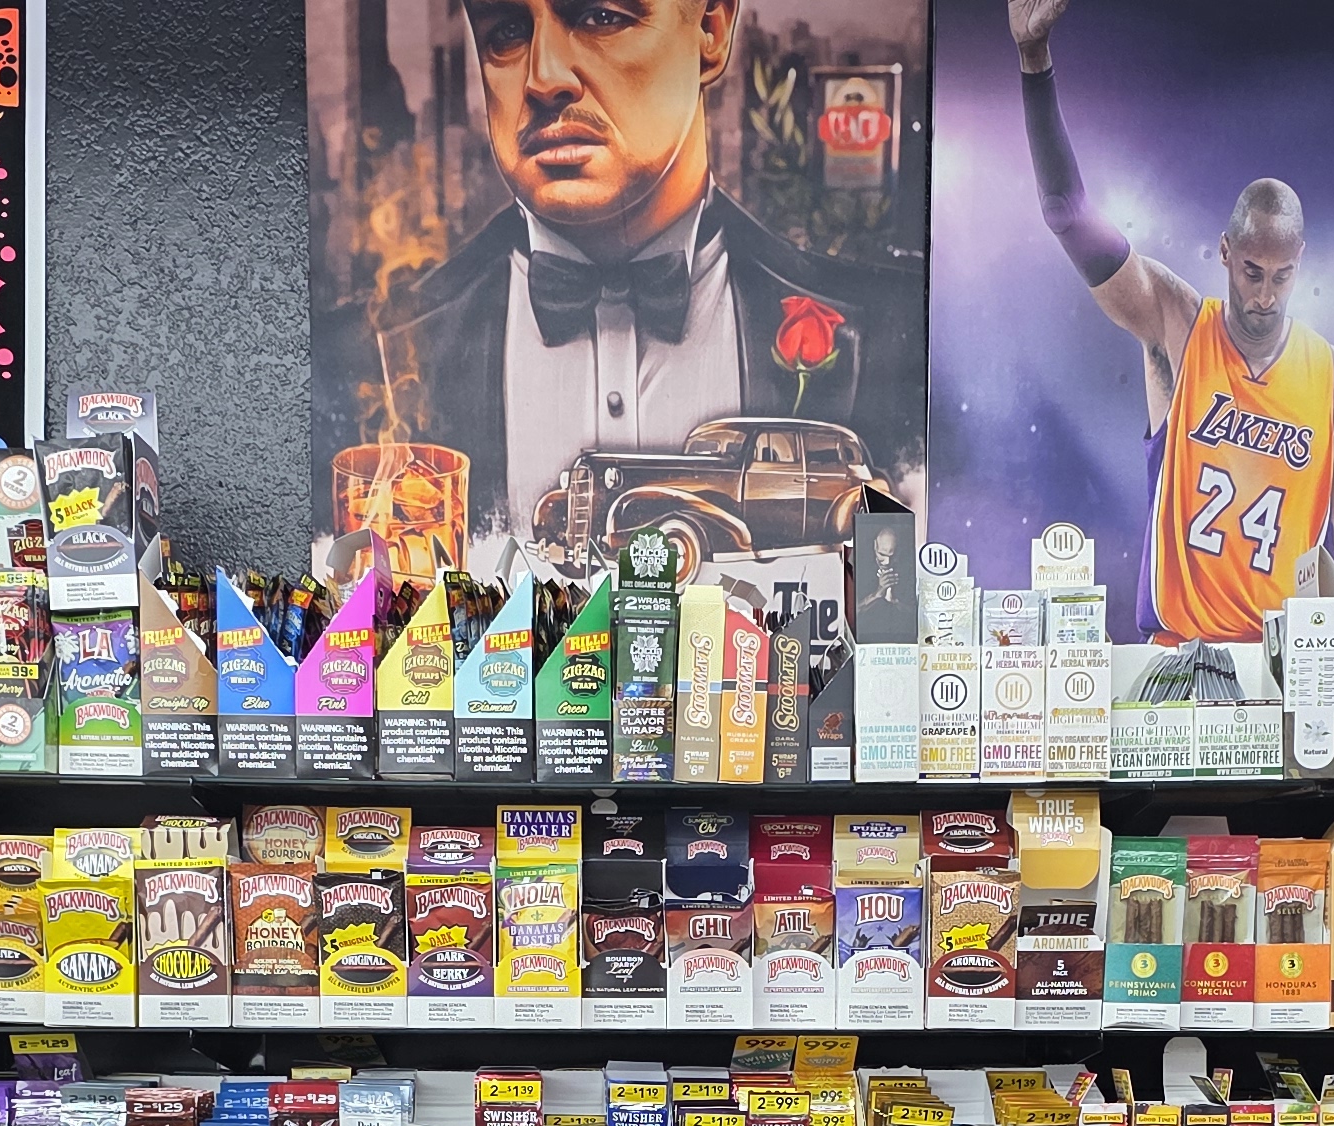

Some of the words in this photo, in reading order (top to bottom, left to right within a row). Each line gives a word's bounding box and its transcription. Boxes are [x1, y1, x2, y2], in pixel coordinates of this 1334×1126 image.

[1189, 391, 1314, 470] LAKERS
[45, 450, 117, 481] BACKWOODS
[1188, 464, 1285, 573] 24
[71, 532, 108, 543] BLACK
[62, 669, 133, 695] Aromatic
[685, 632, 712, 728] SLAPWOODS
[243, 696, 270, 710] Blue
[403, 691, 428, 706] Gold
[620, 709, 665, 717] COFFEE
[620, 718, 665, 727] FLAVOR
[622, 726, 664, 735] WRAPS
[921, 747, 947, 762] GMO
[951, 747, 976, 762] FREE
[1037, 800, 1075, 816] TRUE
[502, 810, 576, 825] BANANAS
[1028, 815, 1085, 835] WRAPS
[509, 823, 570, 838] FOSTER
[939, 881, 1015, 914] BACKWOODS
[857, 896, 902, 924] HOU
[688, 914, 732, 939] CHI
[775, 908, 815, 936] ATL
[250, 927, 298, 940] HONEY
[59, 957, 118, 977] BANANA
[153, 954, 211, 975] CHOCOLATE
[341, 955, 385, 966] ORIGINAL
[1109, 981, 1176, 989] PENNSYLVANIA
[1184, 980, 1247, 988] CONNECTICUT
[1266, 981, 1317, 989] HONDURAS
[1128, 989, 1158, 997] PRIMO
[1198, 988, 1233, 996] SPECIAL
[483, 1110, 537, 1123] SWISHER
